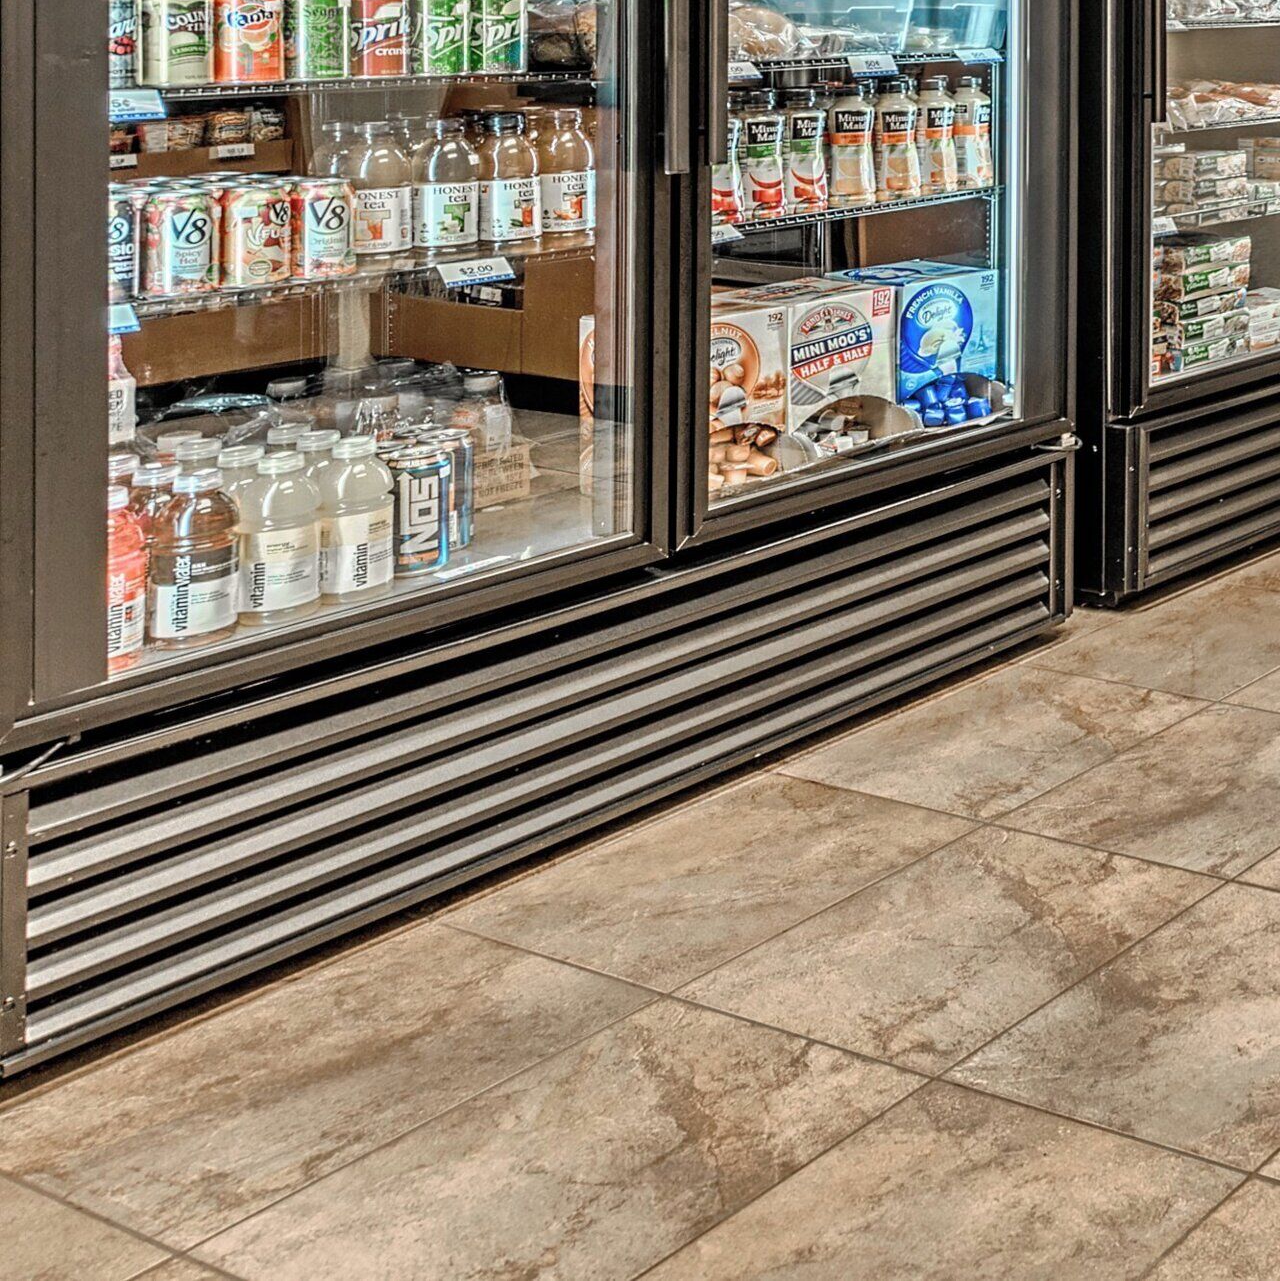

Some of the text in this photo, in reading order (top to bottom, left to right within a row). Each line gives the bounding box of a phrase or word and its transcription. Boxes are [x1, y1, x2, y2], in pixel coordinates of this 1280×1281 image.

[226, 8, 274, 28] Fanta
[552, 174, 589, 184] HONES
[566, 182, 585, 191] tea
[357, 190, 400, 201] ONEST
[448, 194, 468, 203] tea
[518, 190, 535, 198] tea
[272, 201, 290, 226] V8
[308, 196, 347, 232] V8
[363, 201, 386, 210] tea
[171, 208, 208, 245] V8
[175, 250, 204, 260] Spicy
[179, 257, 199, 265] Hot
[460, 264, 493, 276] $2.00
[981, 274, 995, 285] 192
[873, 291, 891, 309] 192
[905, 289, 931, 320] FRENCH
[933, 285, 964, 306] VANILLA
[767, 312, 784, 323] 192
[711, 325, 743, 341] ELNUT
[793, 327, 871, 363] MINI MOO'S
[711, 345, 737, 364] elight
[800, 345, 871, 379] HALF & HALF
[400, 471, 441, 555] NOS
[357, 542, 369, 589] vitamin
[252, 562, 266, 609] vitamin
